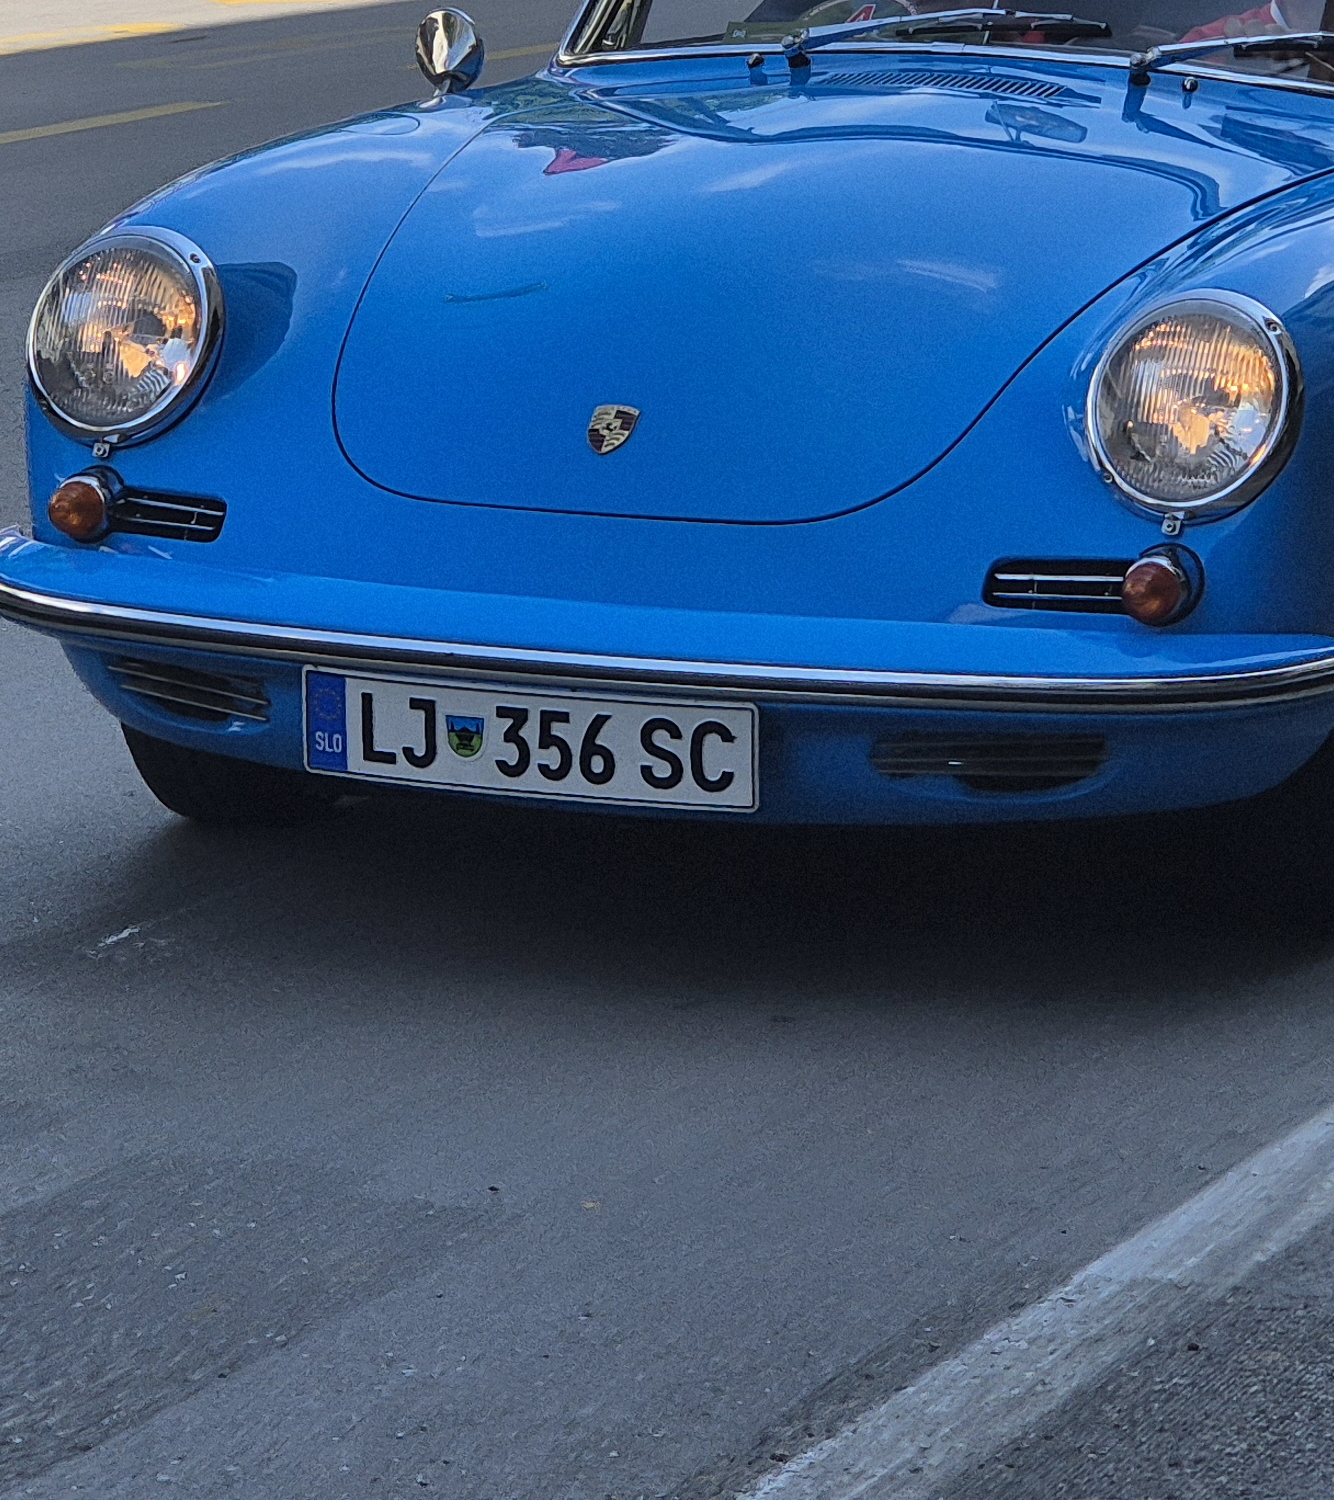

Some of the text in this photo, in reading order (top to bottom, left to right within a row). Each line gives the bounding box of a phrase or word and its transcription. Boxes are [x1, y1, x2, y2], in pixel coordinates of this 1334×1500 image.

[315, 731, 343, 753] SLO
[360, 691, 737, 793] LJ 356 SC
